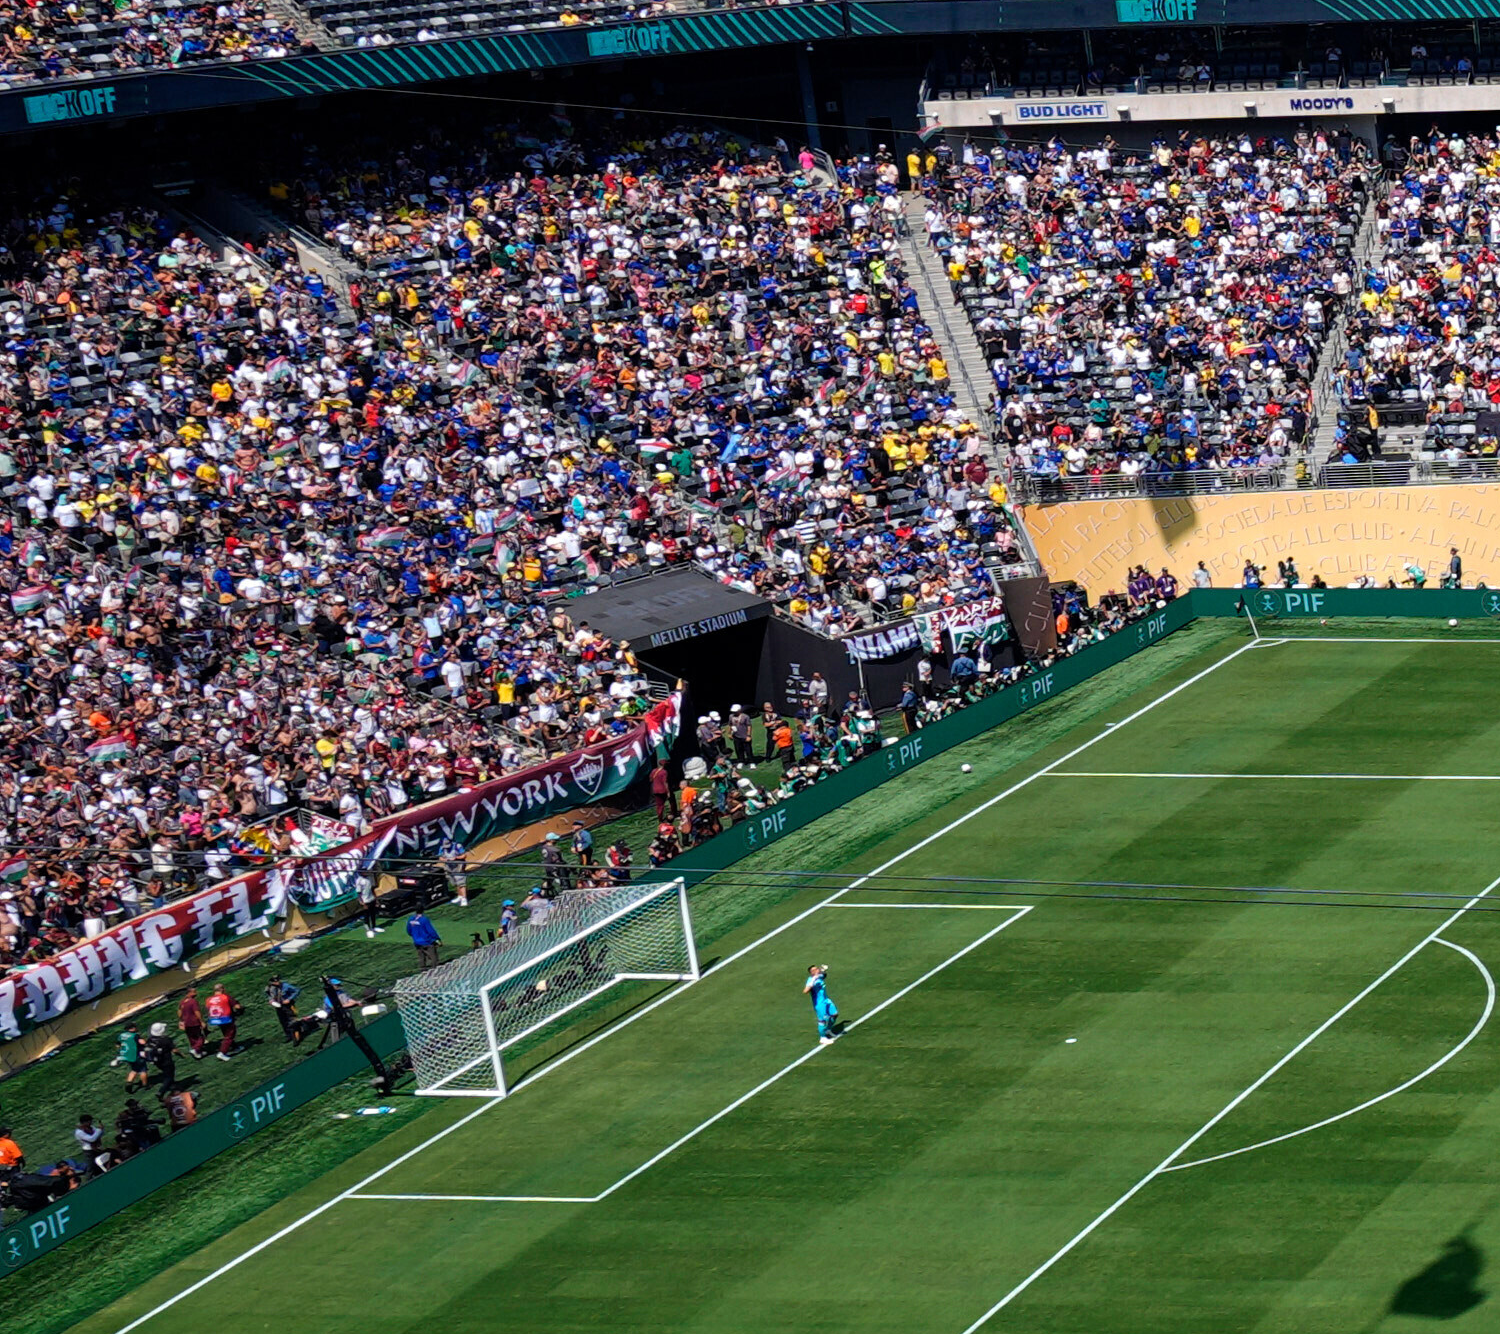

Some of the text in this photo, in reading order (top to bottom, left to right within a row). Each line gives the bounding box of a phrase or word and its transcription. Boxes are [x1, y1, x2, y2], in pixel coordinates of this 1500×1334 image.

[637, 25, 670, 51] OFF
[79, 87, 117, 116] OFF
[1019, 104, 1105, 118] BUD LIGHT
[1285, 593, 1325, 612] PIF
[649, 610, 749, 648] METLIFE STADIUM
[1148, 613, 1167, 639] PIF
[1032, 673, 1053, 699] PIF
[899, 738, 923, 765] PIF
[761, 809, 787, 838] PIF
[249, 1084, 287, 1123] PIF
[29, 1206, 72, 1249] PIF
